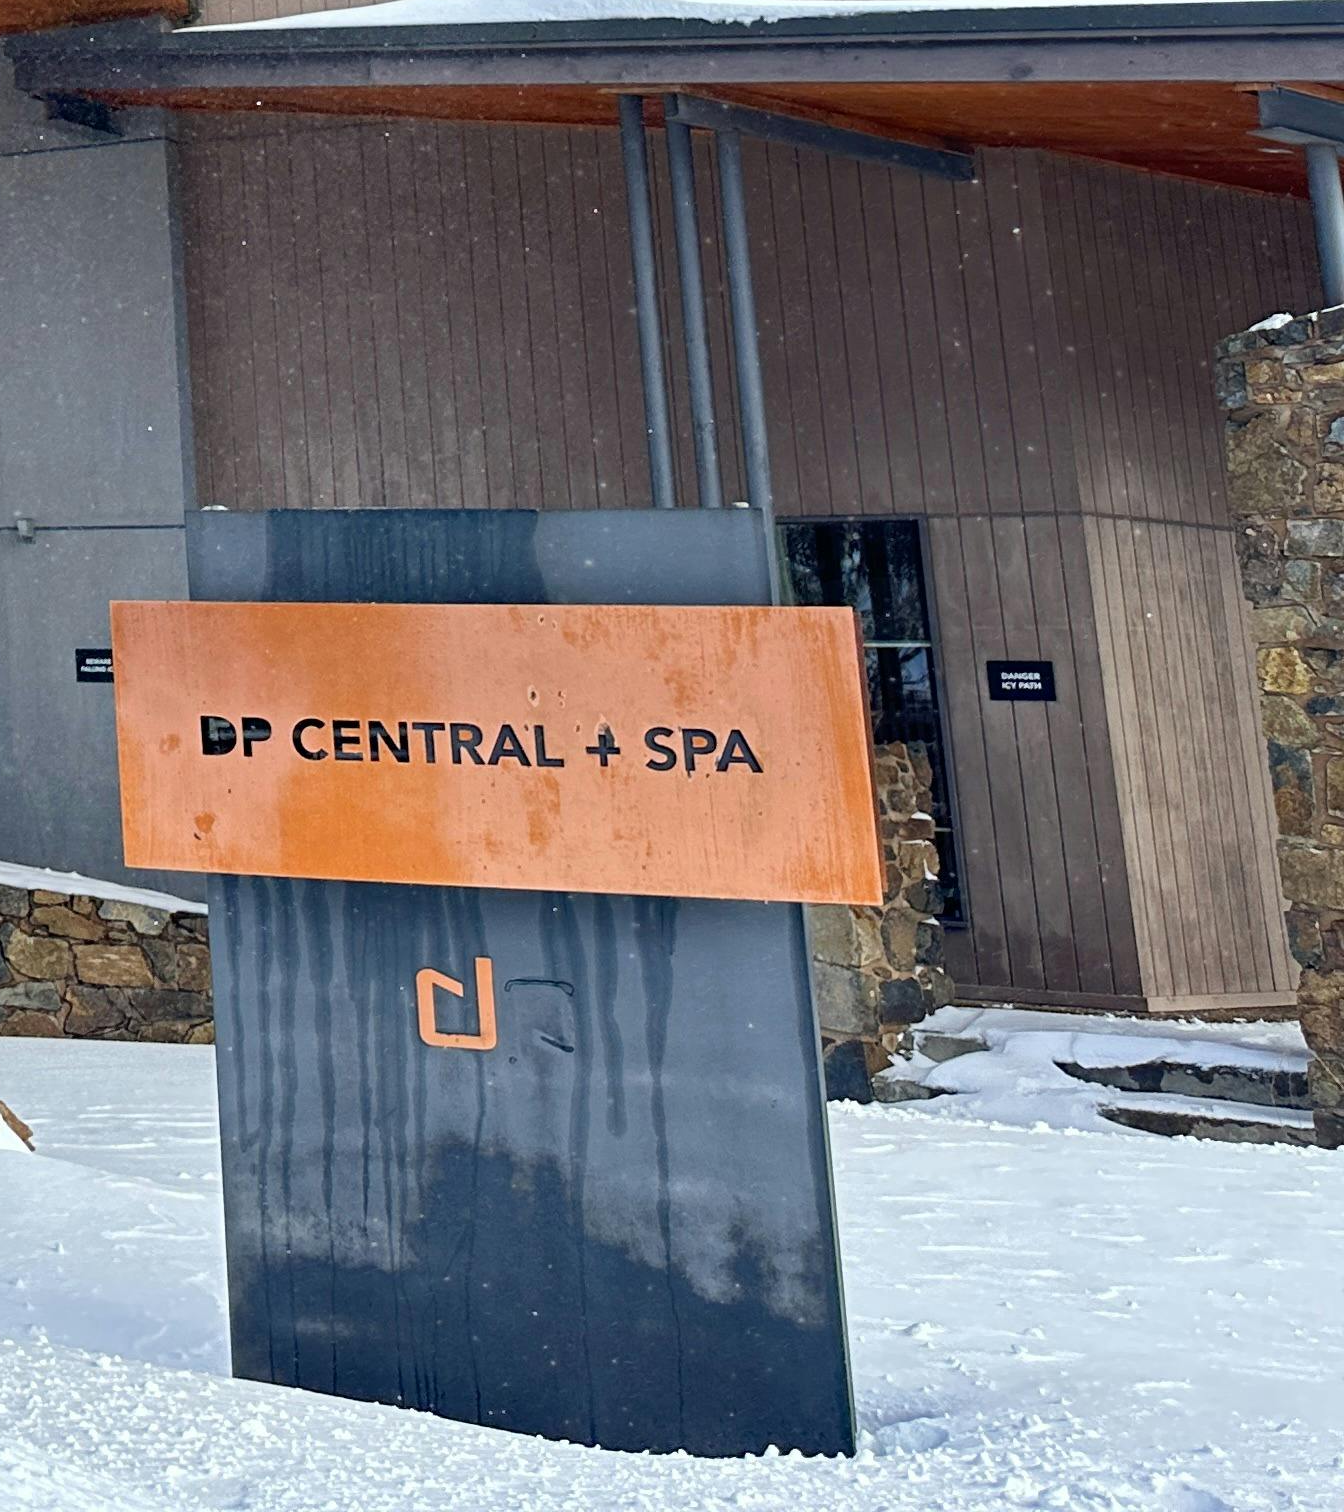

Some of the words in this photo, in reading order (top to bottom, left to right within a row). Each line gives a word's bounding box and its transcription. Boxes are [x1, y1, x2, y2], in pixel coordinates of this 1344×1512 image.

[1000, 672, 1041, 681] DANGER
[1001, 681, 1017, 690] ICY
[1018, 681, 1043, 690] PATH
[199, 715, 272, 758] DP
[291, 718, 565, 769] CENTRAL
[643, 727, 764, 774] SPA
